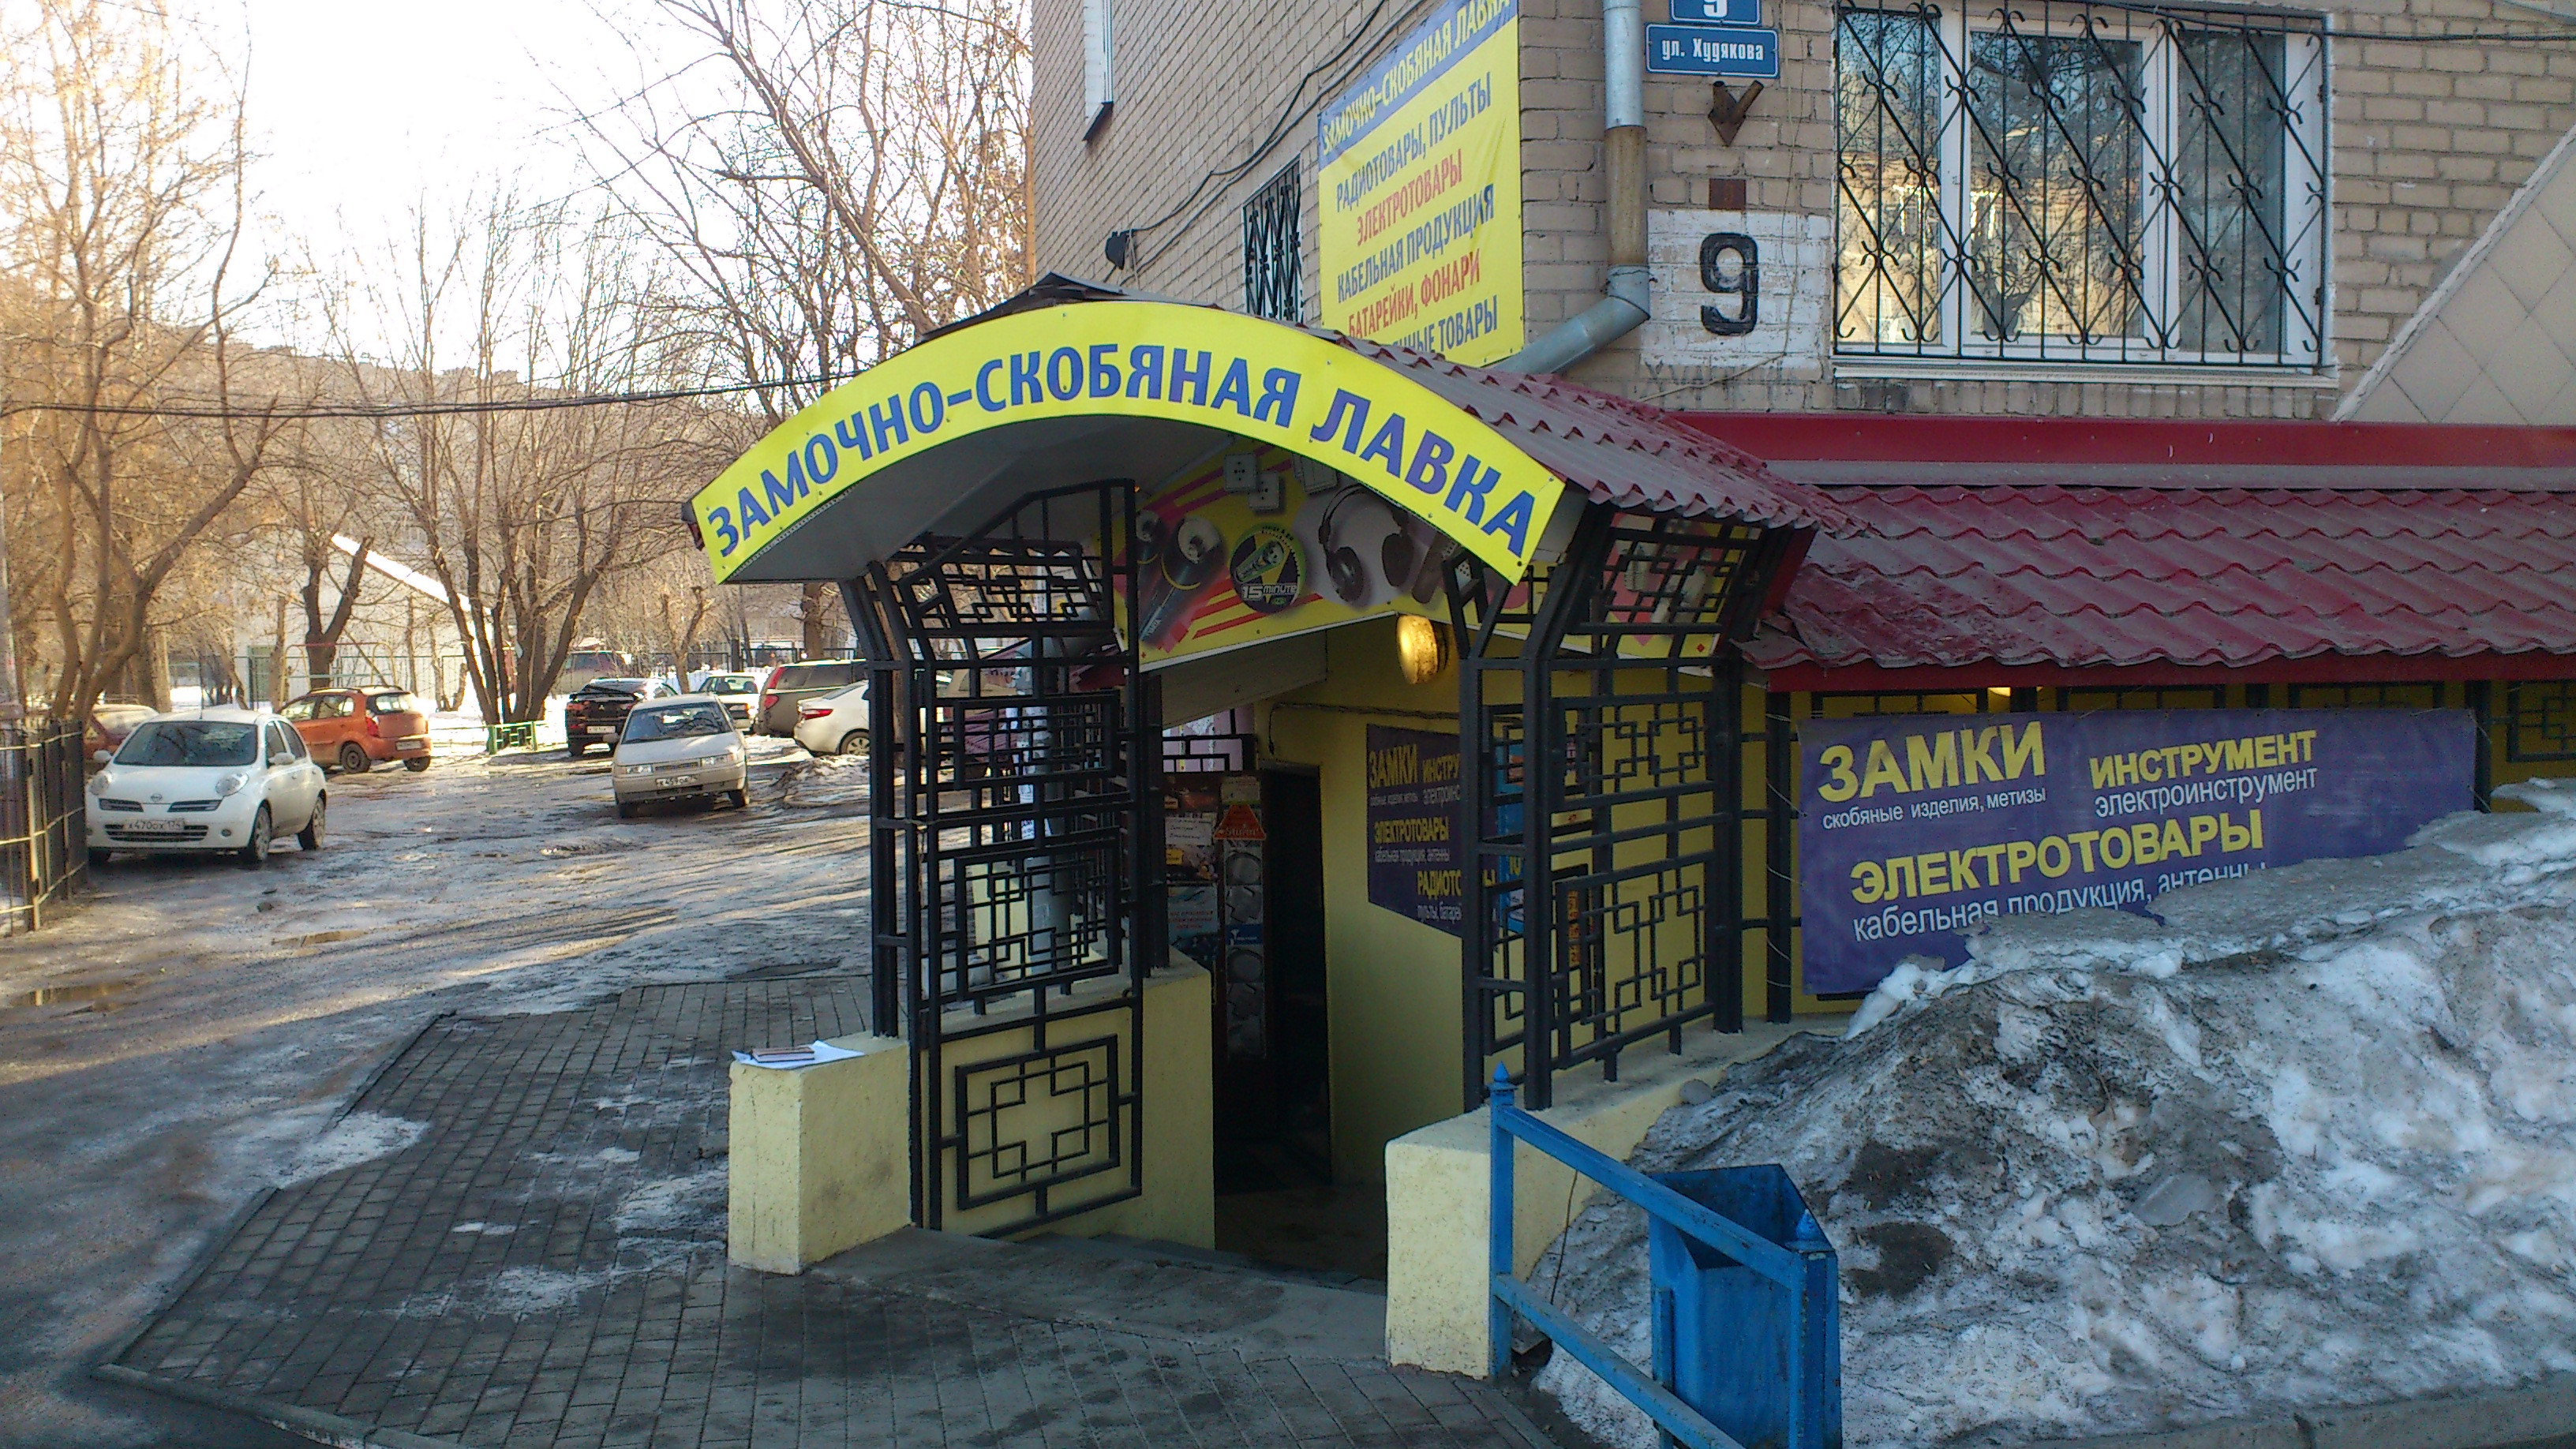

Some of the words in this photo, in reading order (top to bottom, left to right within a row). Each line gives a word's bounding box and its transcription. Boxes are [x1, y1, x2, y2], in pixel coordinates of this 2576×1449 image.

[1661, 39, 1685, 61] ул.
[1693, 37, 1764, 63] Худякова
[1337, 122, 1425, 212] РАДИОТОВАРЫ,
[1429, 72, 1491, 147] ПУЛЬТЫ
[1357, 148, 1462, 246] ЭЛЕКТРОТОВАРЫ
[1337, 238, 1404, 303] КАБЕЛЬНАЯ
[1407, 183, 1494, 265] ПРОДУКЦИЯ
[1699, 232, 1758, 335] 9
[1348, 283, 1418, 339] БАТАРЕЙКИ,
[1421, 249, 1480, 306] ФОНАРИ
[1438, 295, 1497, 352] ТОВАРЫ
[708, 344, 1301, 557] ЗАМОЧНО-СКОБЯНАЯ
[1310, 388, 1535, 558] ЛАВКА
[1368, 744, 1417, 788] ЗАМКИ
[1422, 753, 1460, 783] ИНСТРУ
[1818, 721, 2046, 803] ЗАМКИ
[2090, 730, 2317, 789] ИНСТРУМЕНТ
[1822, 805, 1904, 829] скобяные
[1911, 794, 1985, 819] изделия,
[1986, 788, 2046, 811] метизы
[2095, 767, 2318, 817] электроинструмент
[1374, 816, 1449, 844] ЭЛЕКТРОТОВАРЫ
[1850, 810, 2263, 904] ЭЛЕКТРОТОВАРЫ
[1852, 900, 1998, 942] кабельная
